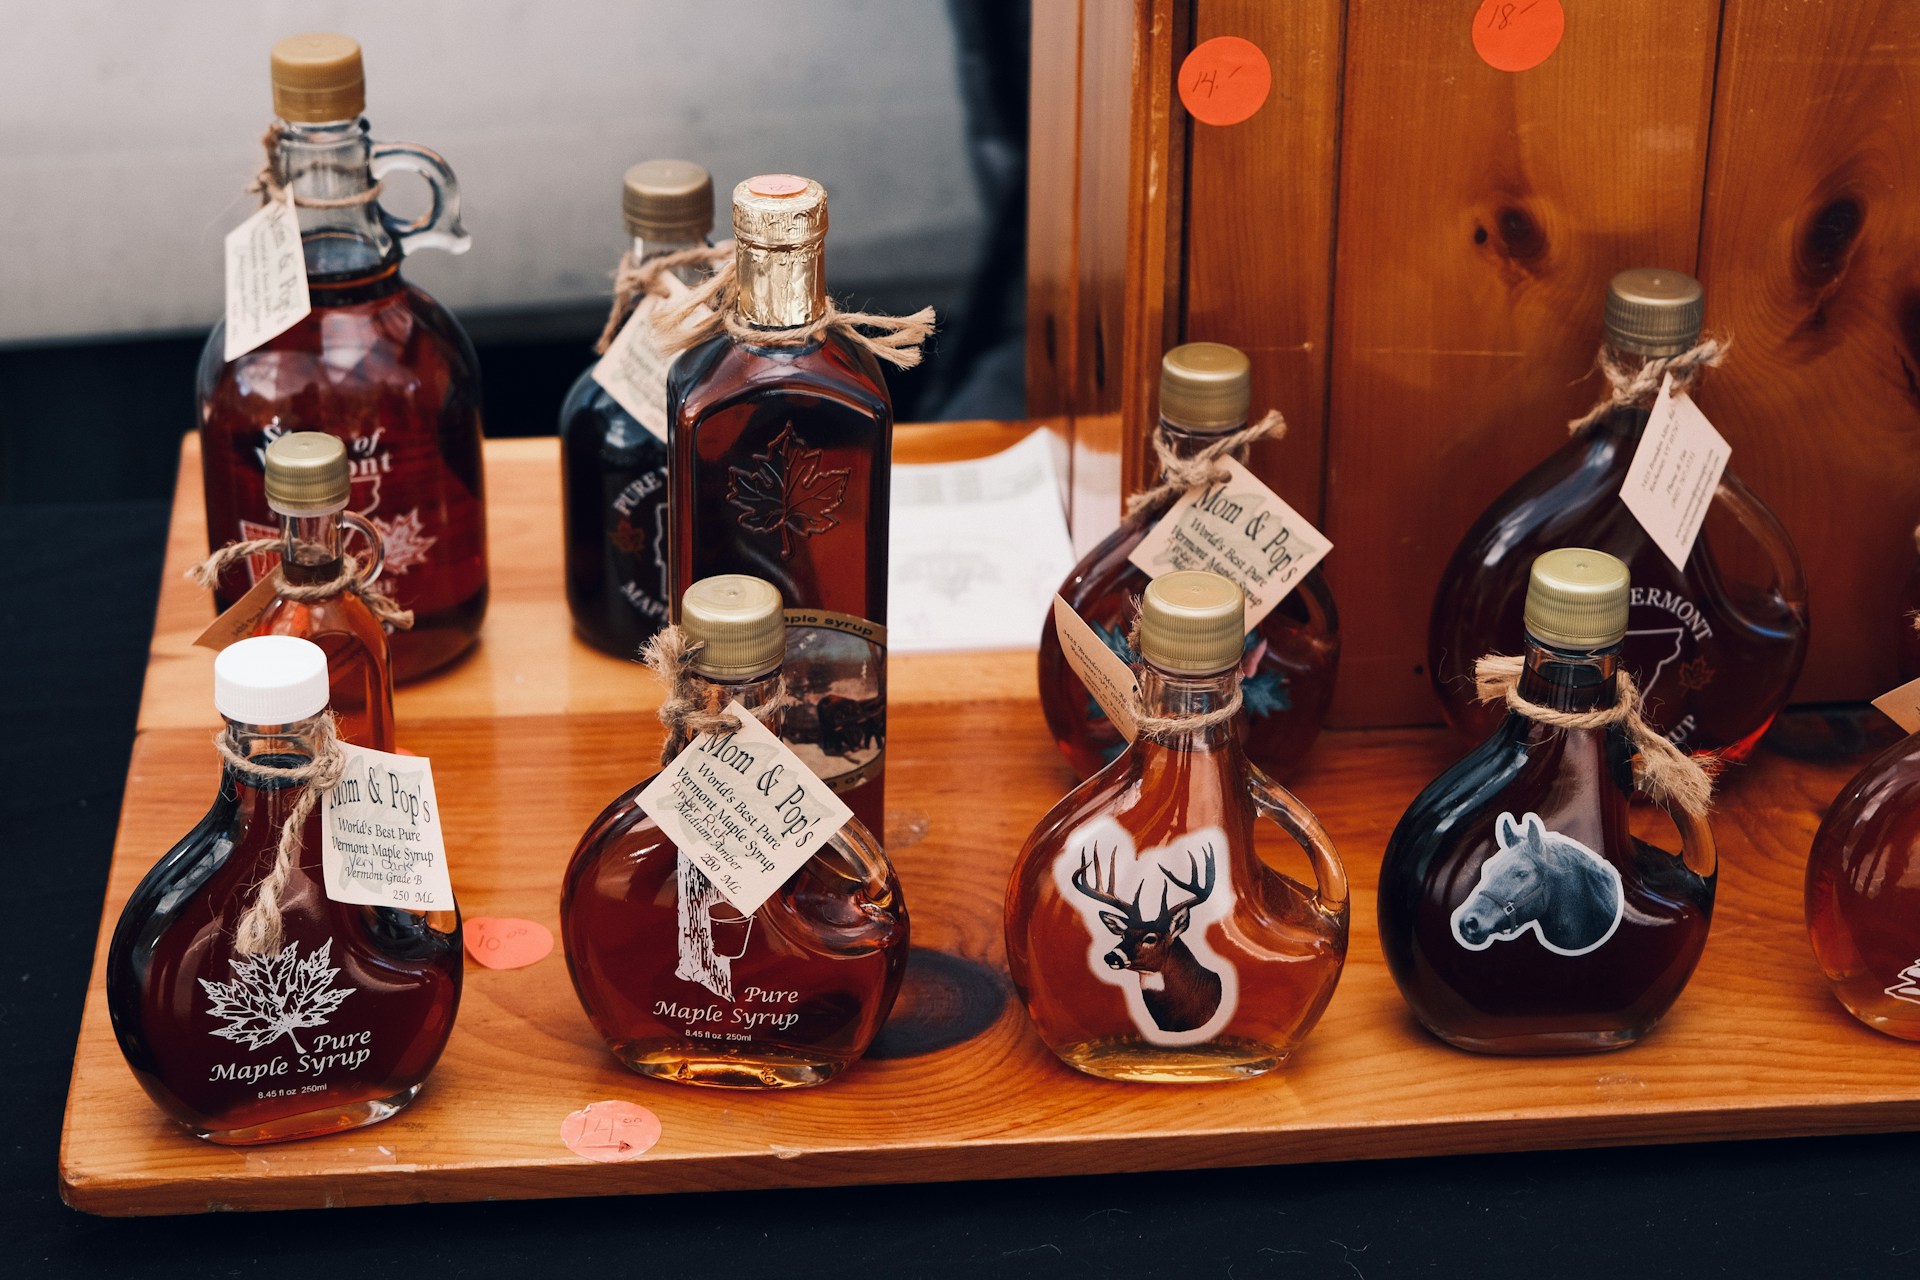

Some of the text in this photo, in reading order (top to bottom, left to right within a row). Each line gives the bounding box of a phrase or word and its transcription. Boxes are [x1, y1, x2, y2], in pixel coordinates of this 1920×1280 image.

[353, 426, 386, 456] of
[613, 471, 662, 516] PURE
[1171, 525, 1208, 560] Vermont
[1191, 485, 1302, 584] Mom & Pop's
[1190, 518, 1267, 588] World's Best Pure
[824, 618, 873, 635] syrup
[1630, 587, 1713, 642] ERMONT
[330, 766, 431, 826] Mom & Pop's
[699, 731, 821, 848] Mom & Pop's
[675, 767, 776, 874] Vermont Maple Syrup
[697, 762, 781, 851] World's Best Pure
[338, 817, 421, 842] World's Best Pure
[674, 802, 743, 871] Medium Amber
[332, 836, 434, 868] Vermont Maple Syrup
[345, 866, 423, 886] Vermont Grade B
[720, 874, 742, 895] ML
[393, 890, 435, 904] 250 ML
[744, 987, 799, 1003] Pure
[652, 1001, 799, 1031] Maple Syrup
[313, 1030, 371, 1053] Pure
[685, 1029, 703, 1038] 8.45
[704, 1031, 710, 1039] fl
[726, 1033, 752, 1042] 250ml
[208, 1048, 370, 1085] Maple Syrup
[257, 1083, 327, 1099] 8.45 fl oz 250ml
